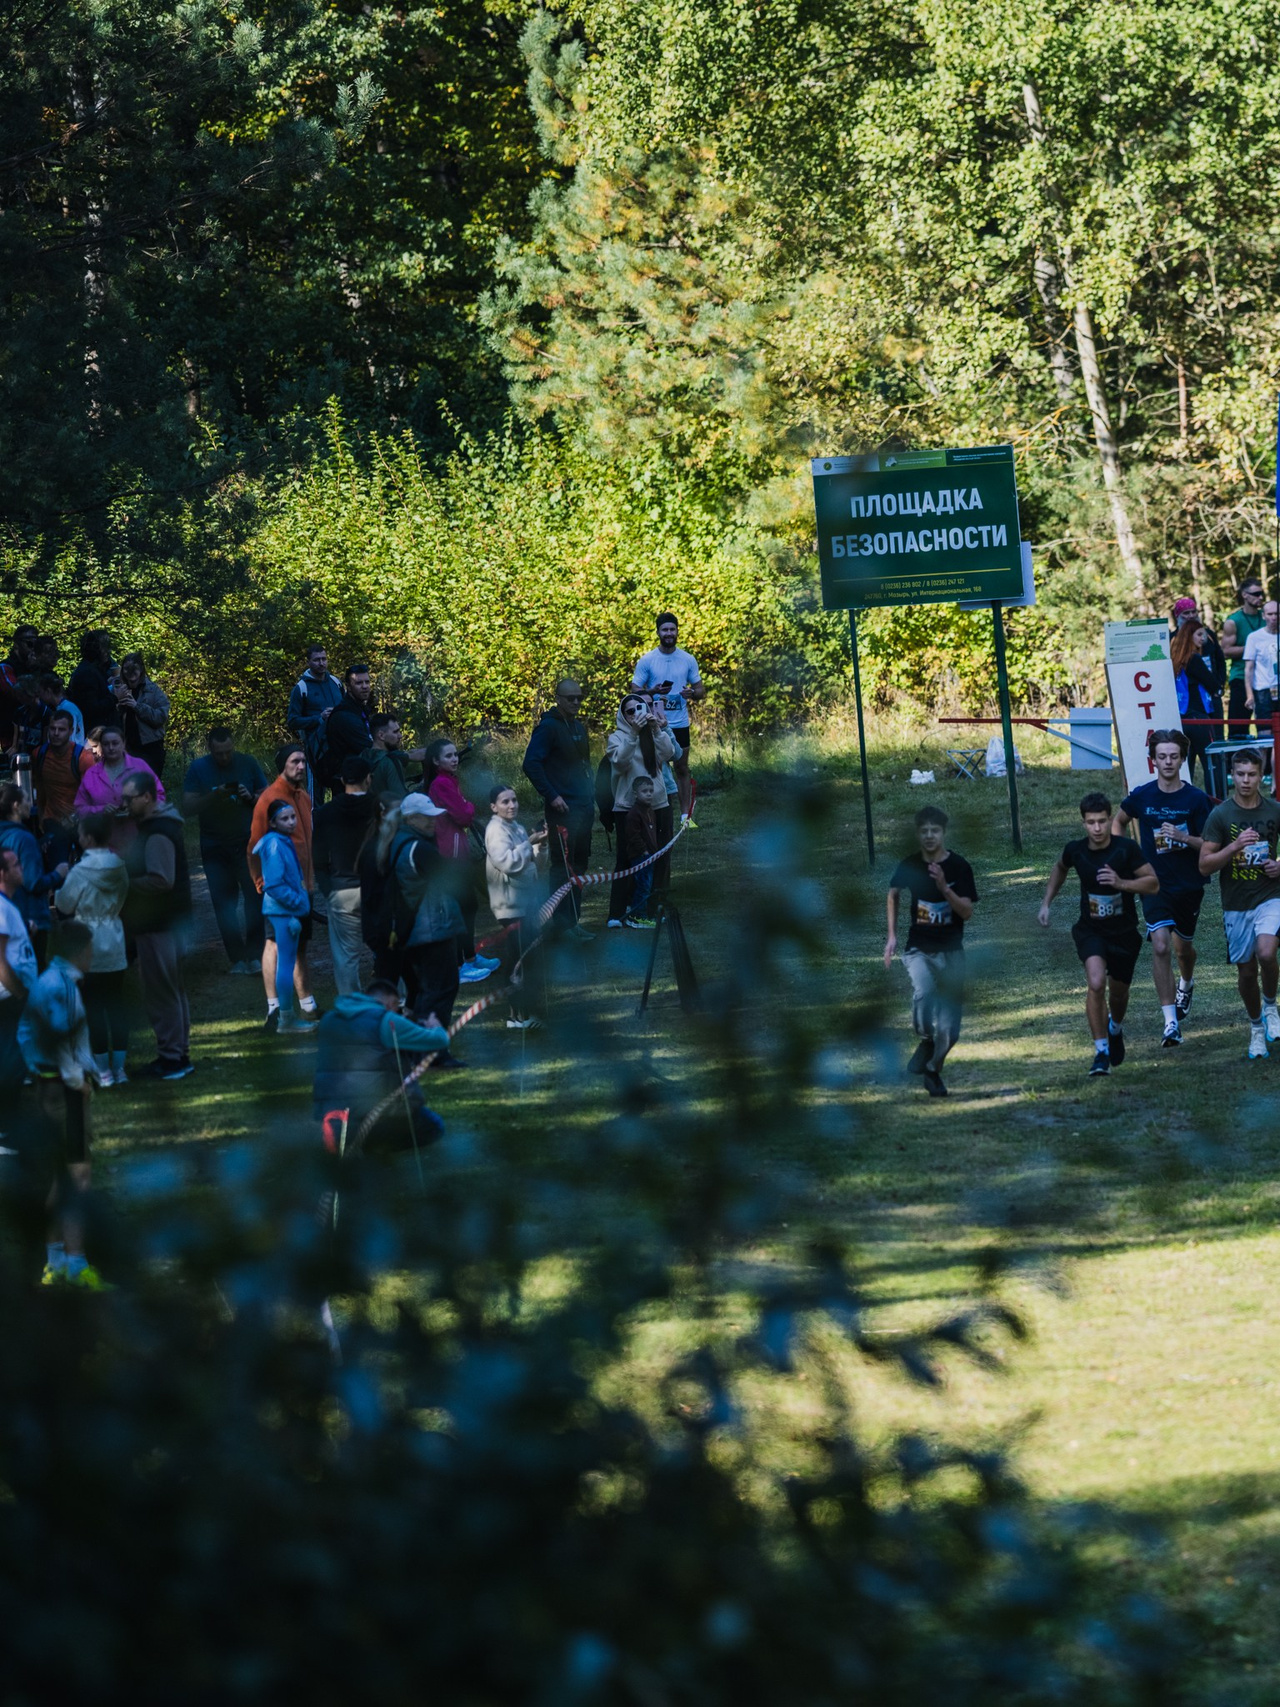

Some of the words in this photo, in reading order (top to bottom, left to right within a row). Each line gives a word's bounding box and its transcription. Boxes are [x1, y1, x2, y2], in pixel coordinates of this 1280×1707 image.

[850, 487, 984, 518] ПЛОЩАДКА
[831, 524, 1008, 559] БЕЗОПАСНОСТИ
[1244, 852, 1261, 865] 92
[1098, 904, 1113, 917] 88
[928, 911, 942, 924] 91
